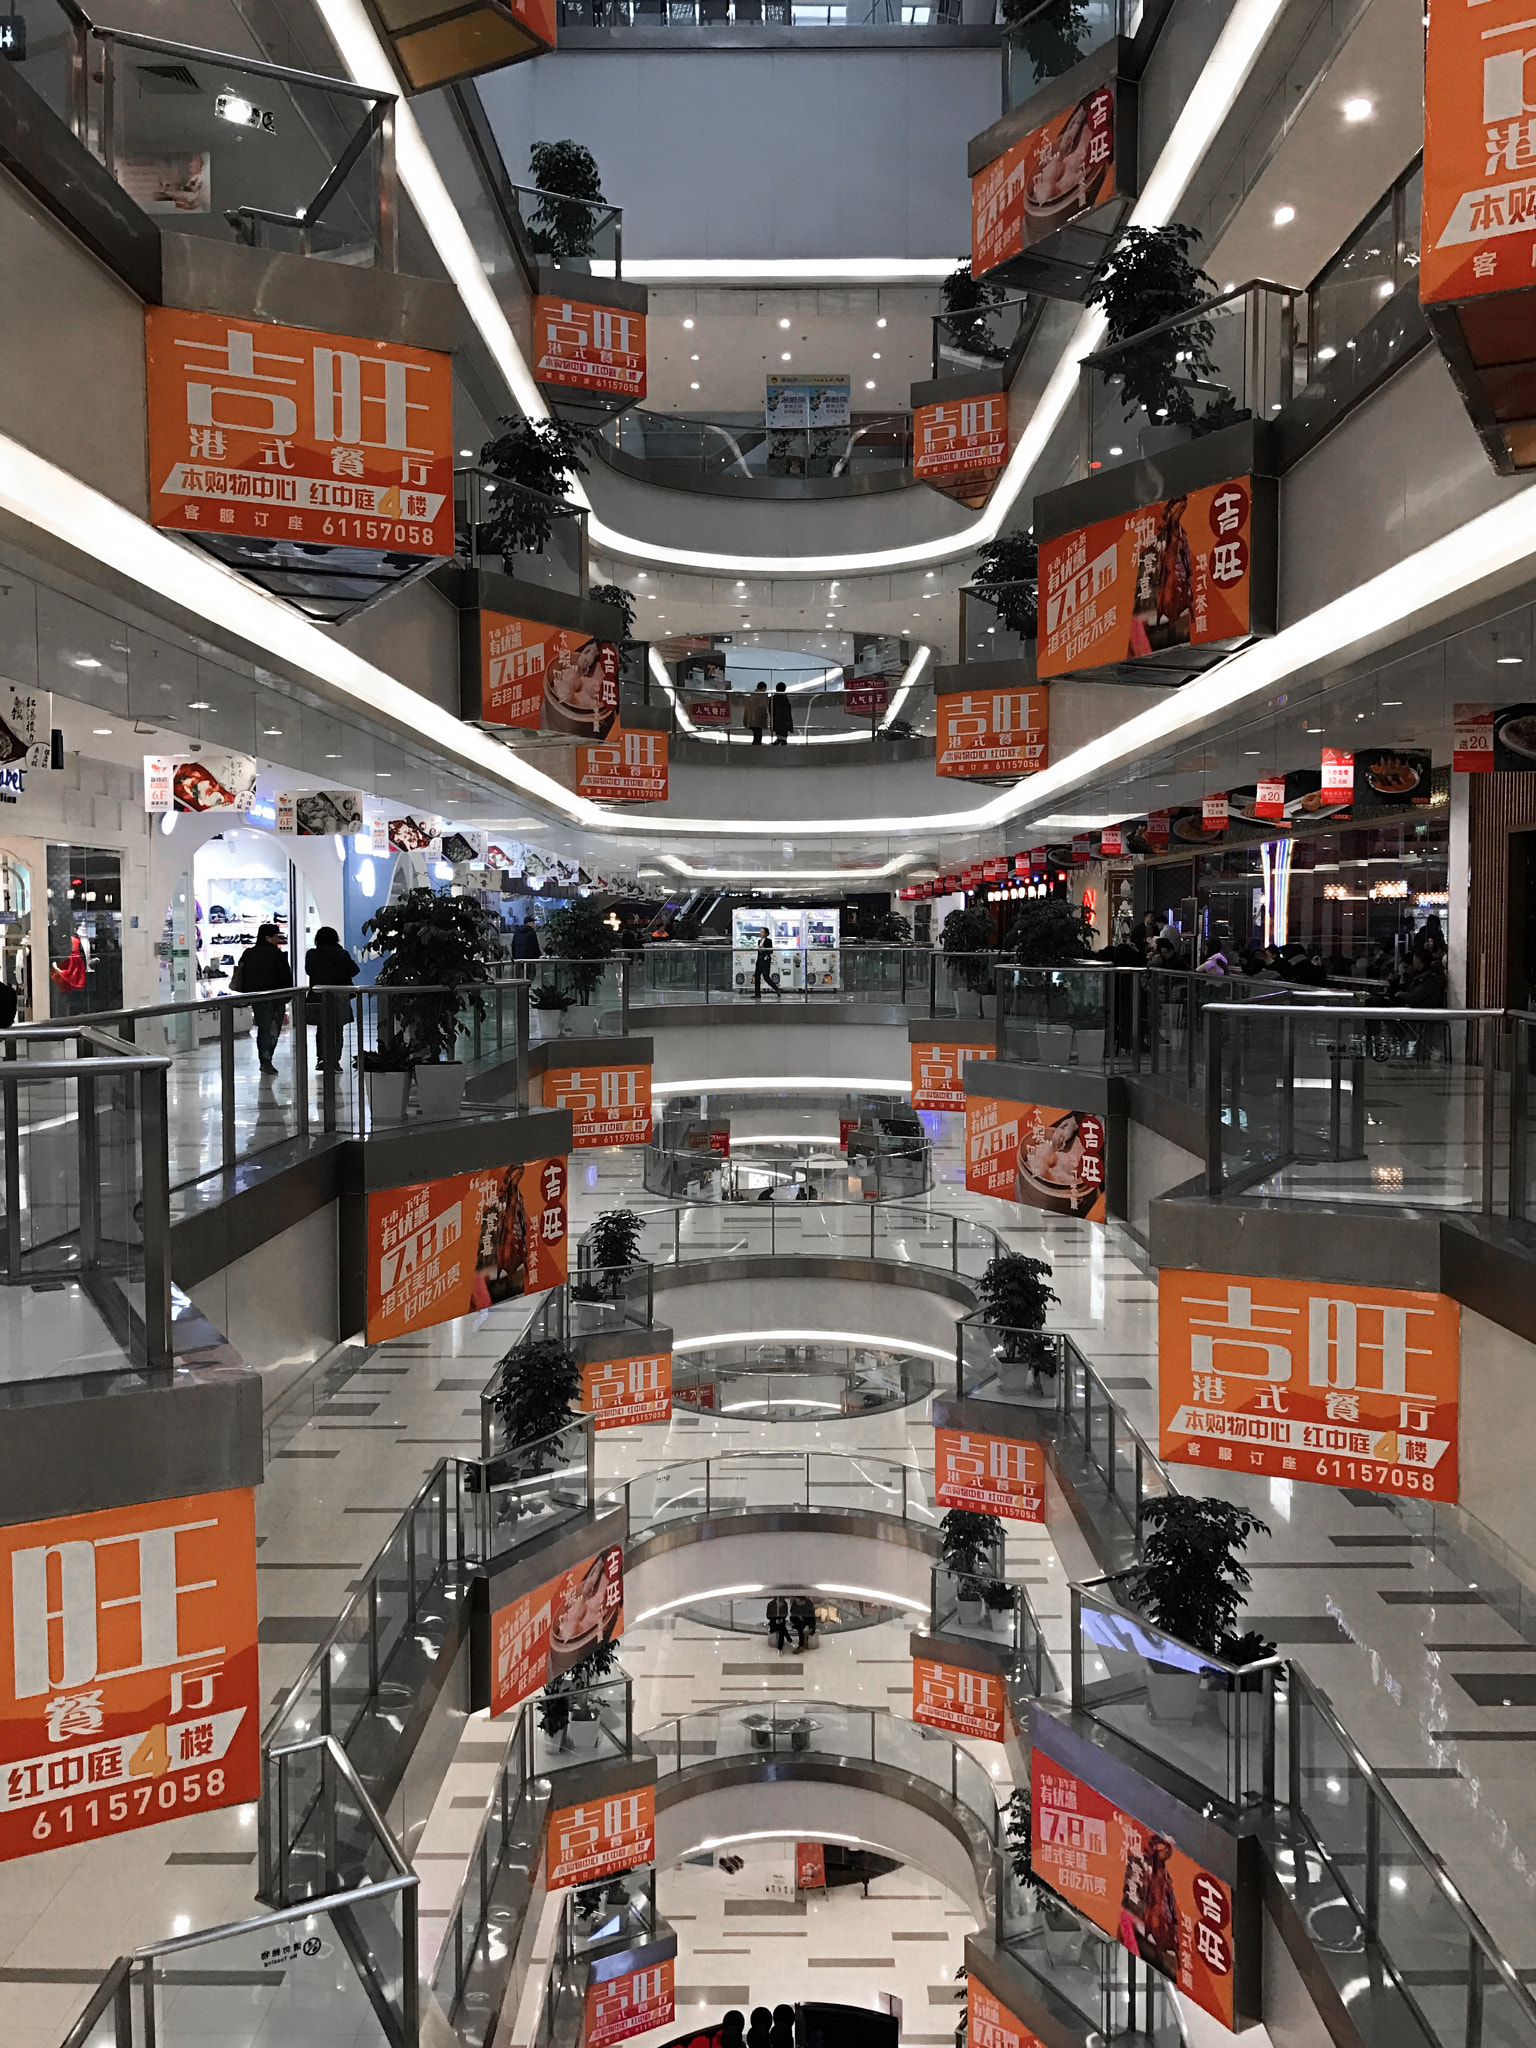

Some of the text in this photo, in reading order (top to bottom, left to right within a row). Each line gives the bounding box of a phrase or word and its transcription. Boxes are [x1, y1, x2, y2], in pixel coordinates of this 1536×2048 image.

[1089, 95, 1110, 164] 吉旺
[544, 304, 639, 355] 吉旺
[548, 342, 639, 368] 港式餐厅
[174, 330, 434, 455] 吉旺
[597, 381, 639, 392] 61157058
[921, 399, 1001, 442] 吉旺
[190, 427, 434, 486] 港式餐厅
[964, 456, 1000, 468] 61157058
[181, 469, 427, 520] 本购物中心 红中庭4楼
[184, 504, 433, 546] 客服订座 61157058
[1212, 493, 1244, 581] 吉旺
[1047, 543, 1117, 634] 7.8折
[1048, 550, 1086, 594] 有优惠
[490, 631, 522, 655] 有优惠
[1048, 600, 1096, 656] 港式美味
[1066, 605, 1117, 663] 好吃不贵
[489, 643, 544, 689] 7.8折
[602, 648, 617, 705] 吉旺
[696, 706, 727, 716] 人气餐厅
[945, 693, 1040, 736] 吉旺
[587, 734, 662, 766] 吉旺
[949, 731, 1039, 748] 港式餐厅
[996, 760, 1039, 770] 61157058
[152, 790, 167, 800] 6F
[280, 818, 292, 826] 6F
[552, 1071, 645, 1110] 吉旺
[582, 1106, 645, 1121] 式餐厅
[604, 1133, 645, 1143] 61157058
[971, 1120, 1018, 1162] 7.8折
[972, 1113, 997, 1133] 有优惠
[1082, 1120, 1101, 1183] 吉旺
[541, 1165, 563, 1239] 吉旺
[381, 1201, 461, 1295] 7.8折
[382, 1201, 429, 1250] 有优惠
[382, 1258, 440, 1319] 港式美味
[404, 1262, 460, 1323] 好吃不贵
[1182, 1286, 1437, 1401] 吉旺
[589, 1358, 666, 1398] 吉旺
[631, 1411, 666, 1422] 61157058
[1193, 1375, 1435, 1431] 港式餐厅
[944, 1435, 1036, 1483] 吉旺
[1185, 1411, 1427, 1464] 本购物中心 红中庭4楼
[948, 1471, 1036, 1495] 港式餐厅
[1187, 1443, 1435, 1492] 客服订座 61157058
[994, 1506, 1036, 1519] 61157058
[606, 1551, 621, 1606] 吉旺
[11, 1518, 226, 1700] 旺
[44, 1662, 225, 1743] 餐厅
[920, 1665, 996, 1710] 吉旺
[961, 1726, 996, 1739] 61157058
[8, 1723, 214, 1802] 红中庭4楼
[32, 1768, 226, 1840] 61157058
[1040, 1786, 1077, 1810] 有优惠
[557, 1793, 648, 1850] 吉旺
[1040, 1807, 1106, 1855] 7.8折
[607, 1854, 647, 1872] 61157058
[1041, 1844, 1087, 1871] 港式美味
[1059, 1868, 1106, 1896] 好吃不贵
[1198, 1877, 1227, 1973] 吉旺
[593, 1964, 668, 2017] 吉旺
[635, 2016, 668, 2032] 61157058
